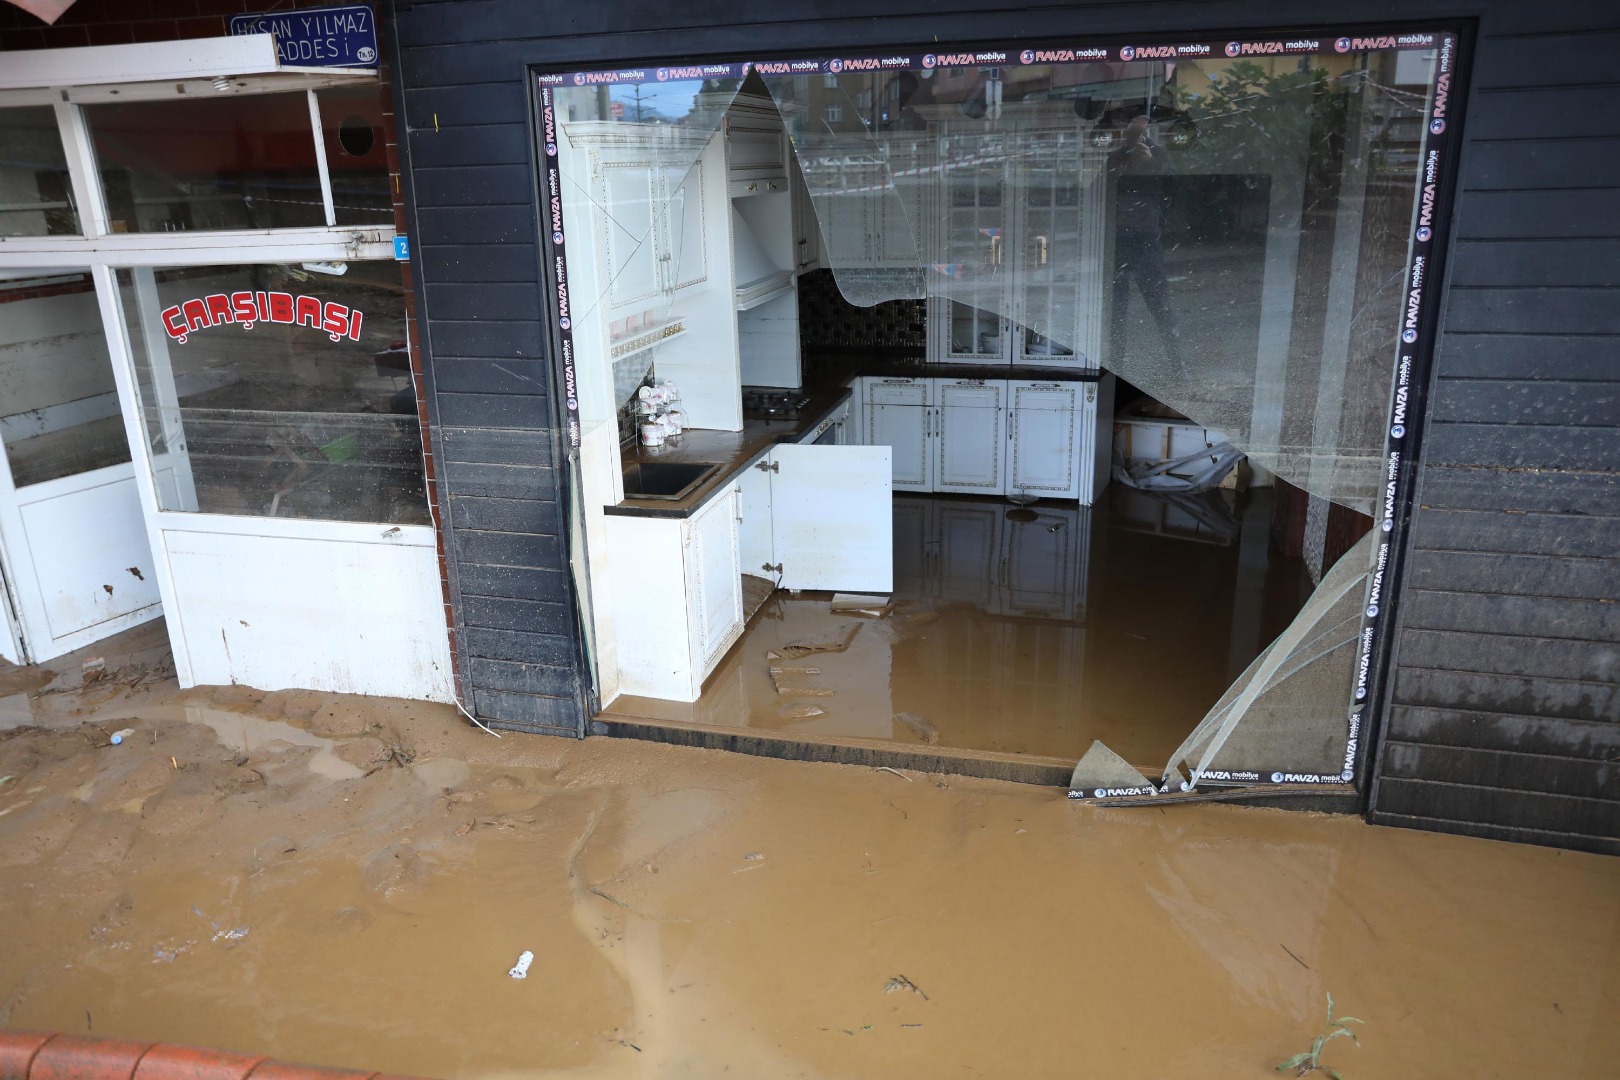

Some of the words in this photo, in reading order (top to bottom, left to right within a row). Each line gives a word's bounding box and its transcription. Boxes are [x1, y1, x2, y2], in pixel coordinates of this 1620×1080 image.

[301, 13, 368, 37] YILMAZ
[1035, 49, 1075, 62] RAVZA
[1076, 48, 1107, 58] mobilya
[1135, 46, 1177, 59] RAVZA
[1178, 44, 1210, 55] mobilya
[1241, 41, 1284, 55] RAVZA
[1285, 40, 1319, 50] mobilya
[1351, 36, 1396, 50] RAVZA
[1398, 34, 1433, 45] mobilya
[1440, 38, 1451, 72] mobilya
[669, 67, 703, 79] RAVZA
[704, 65, 730, 75] mobilya
[755, 62, 790, 74] RAVZA
[791, 61, 819, 71] mobilya
[843, 58, 881, 70] RAVZA
[881, 56, 910, 67] mobilya
[937, 53, 976, 66] RAVZA
[976, 52, 1006, 63] mobilya
[587, 72, 619, 84] RAVZA
[619, 71, 645, 80] mobilya
[1433, 73, 1450, 118] RAVZA
[543, 106, 553, 142] RAVZA
[1426, 150, 1437, 183] mobilya
[549, 168, 557, 196] mobilya
[552, 196, 562, 232] RAVZA
[1419, 183, 1436, 226] RAVZA
[400, 242, 408, 255] 2
[1412, 256, 1423, 288] mobilya
[559, 282, 569, 317] RAVZA
[1405, 288, 1421, 328] RAVZA
[161, 291, 363, 344] ÇARŞIBAŞI
[565, 365, 576, 398] RAVZA
[1399, 355, 1409, 385] mobilya
[1393, 386, 1408, 424] RAVZA
[1388, 451, 1397, 480] mobilya
[1384, 480, 1396, 518] RAVZA
[1369, 571, 1383, 605] RAVZA
[1358, 652, 1370, 687] RAVZA
[1344, 738, 1357, 770] RAVZA
[1198, 771, 1231, 780] RAVZA
[1232, 772, 1259, 780] mobilya
[1285, 773, 1320, 783] RAVZA
[1107, 788, 1141, 798] RAVZA
